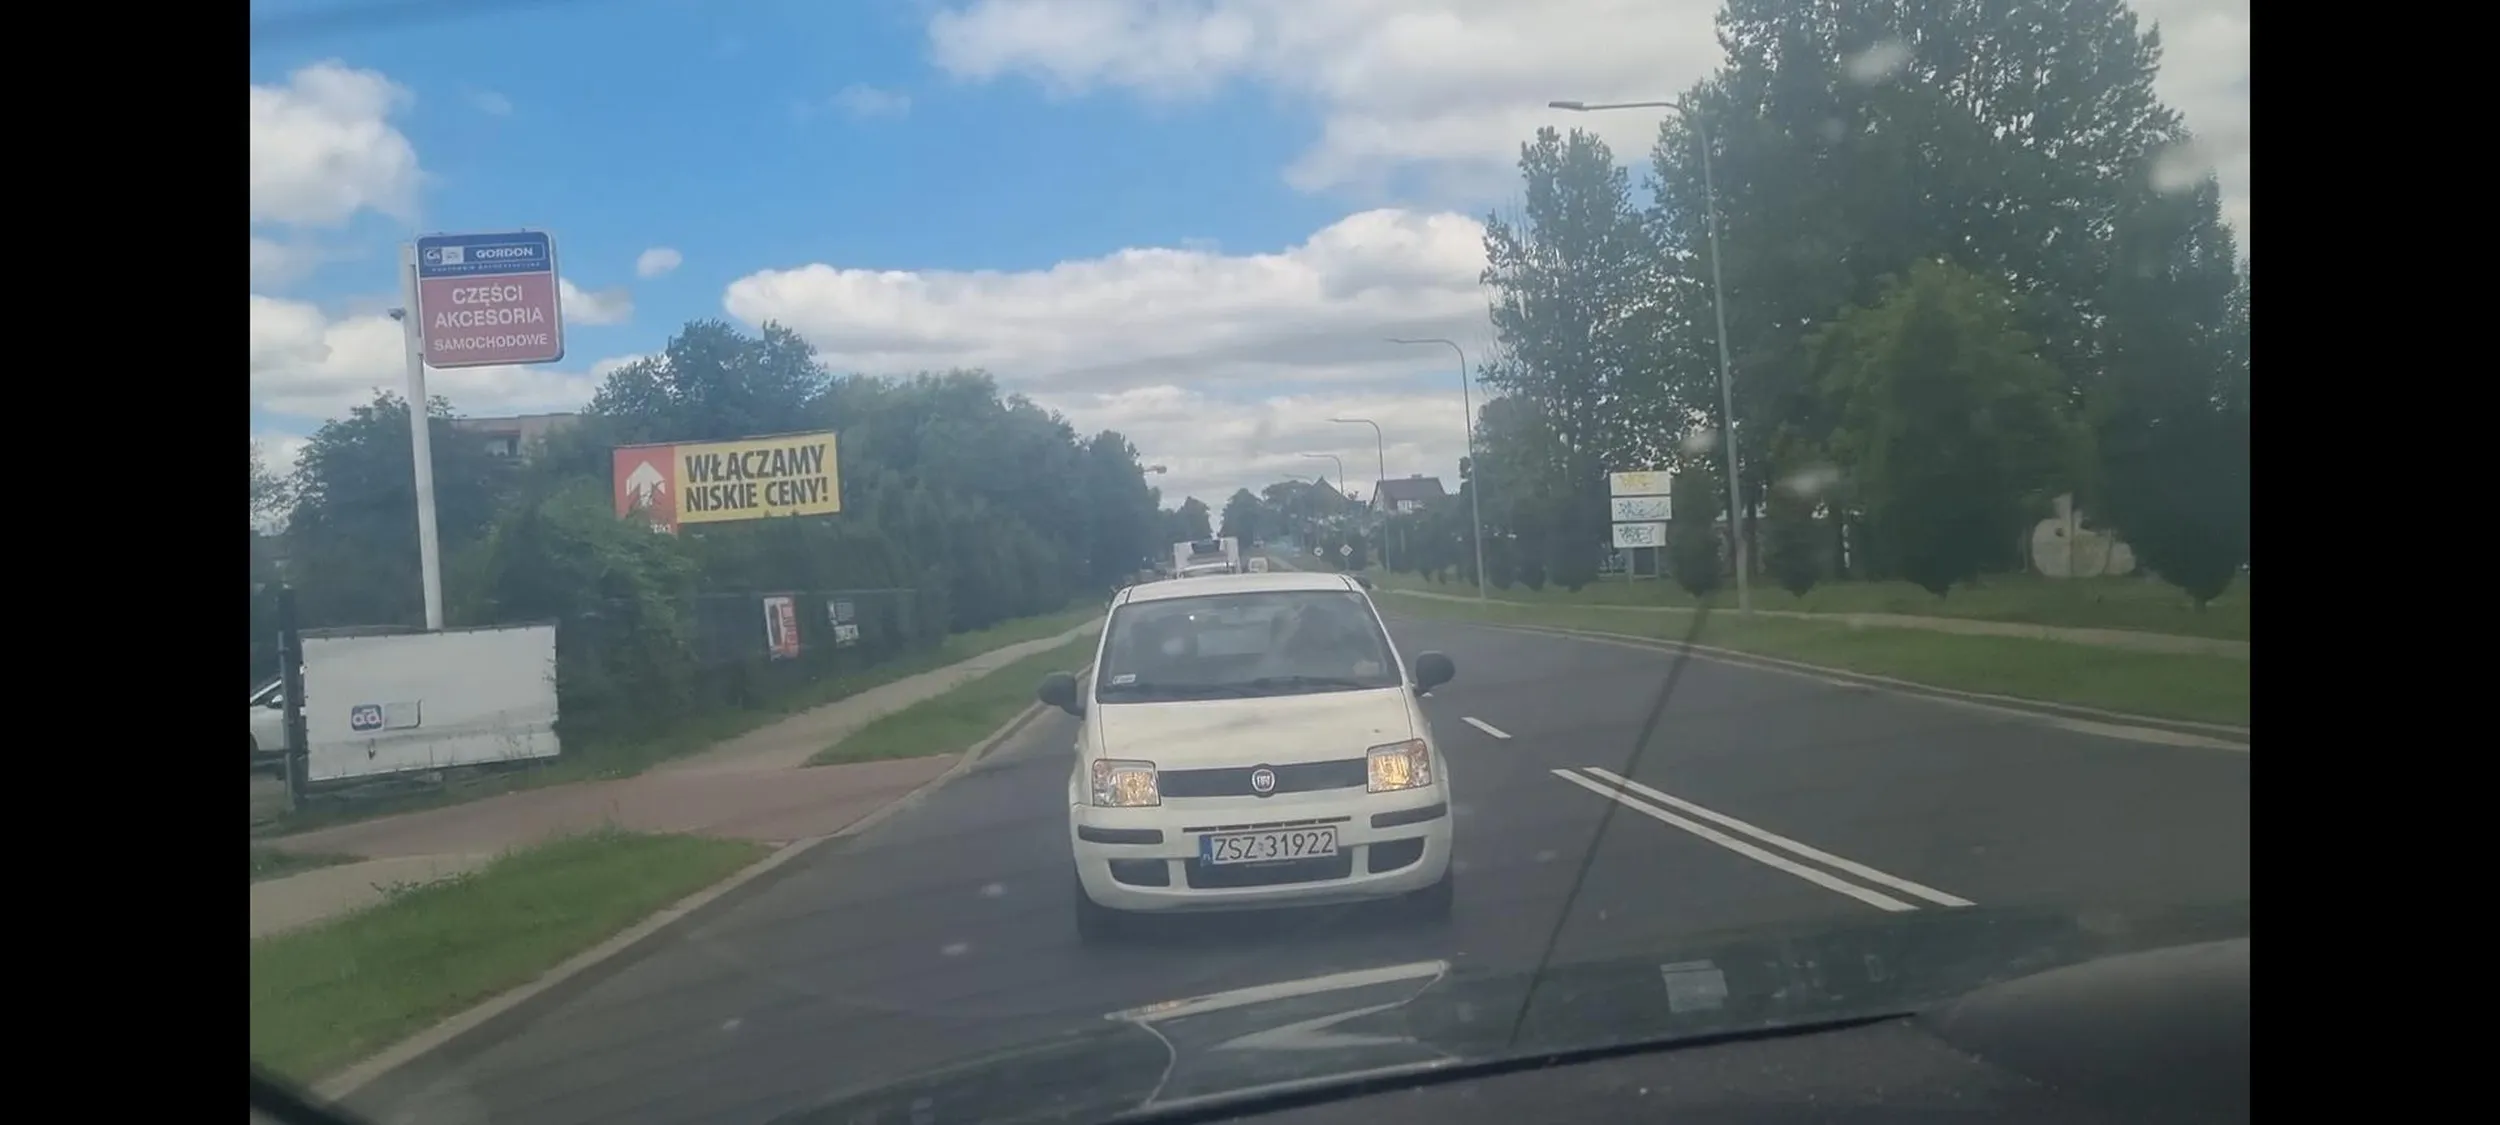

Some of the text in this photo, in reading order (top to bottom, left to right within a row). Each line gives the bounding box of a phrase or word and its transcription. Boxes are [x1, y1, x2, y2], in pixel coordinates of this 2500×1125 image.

[476, 247, 533, 259] GORDON
[452, 283, 522, 306] CZĘŚCI
[435, 307, 544, 329] AKCESORIA
[434, 333, 548, 351] SAMOCHODOWE
[686, 477, 828, 513] NISKIE CENY!
[1214, 831, 1334, 861] ZSZ 31922
